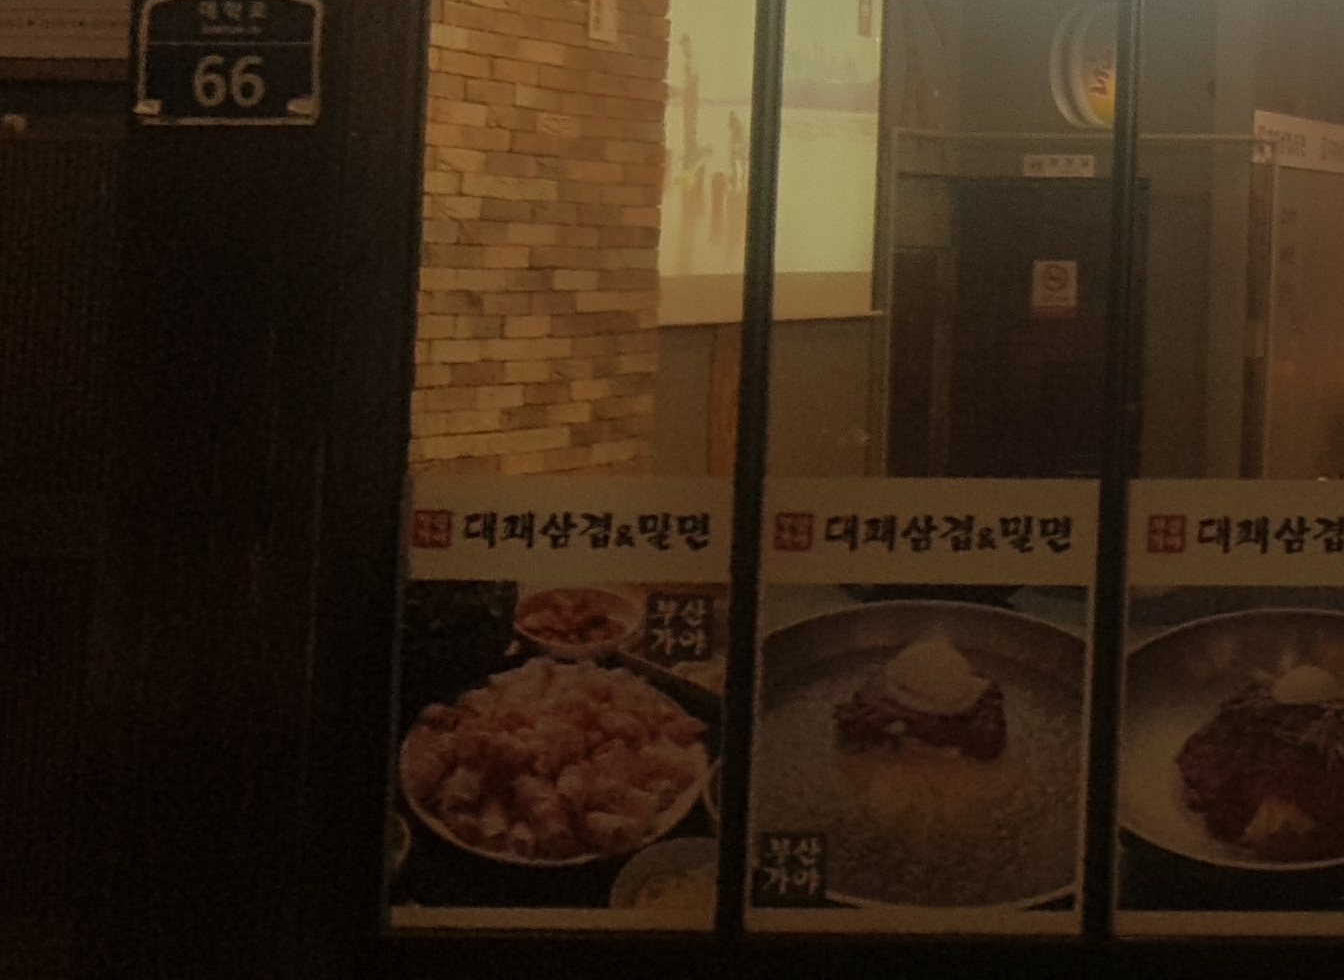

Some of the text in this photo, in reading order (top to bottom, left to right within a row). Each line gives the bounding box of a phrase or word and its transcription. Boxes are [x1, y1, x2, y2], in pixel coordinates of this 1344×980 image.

[193, 55, 265, 107] 66
[463, 510, 711, 552] 대패삼겹&밀면
[824, 514, 1072, 554] 대패삼겹&밀면
[650, 626, 706, 655] 가야
[761, 866, 821, 895] 가야
